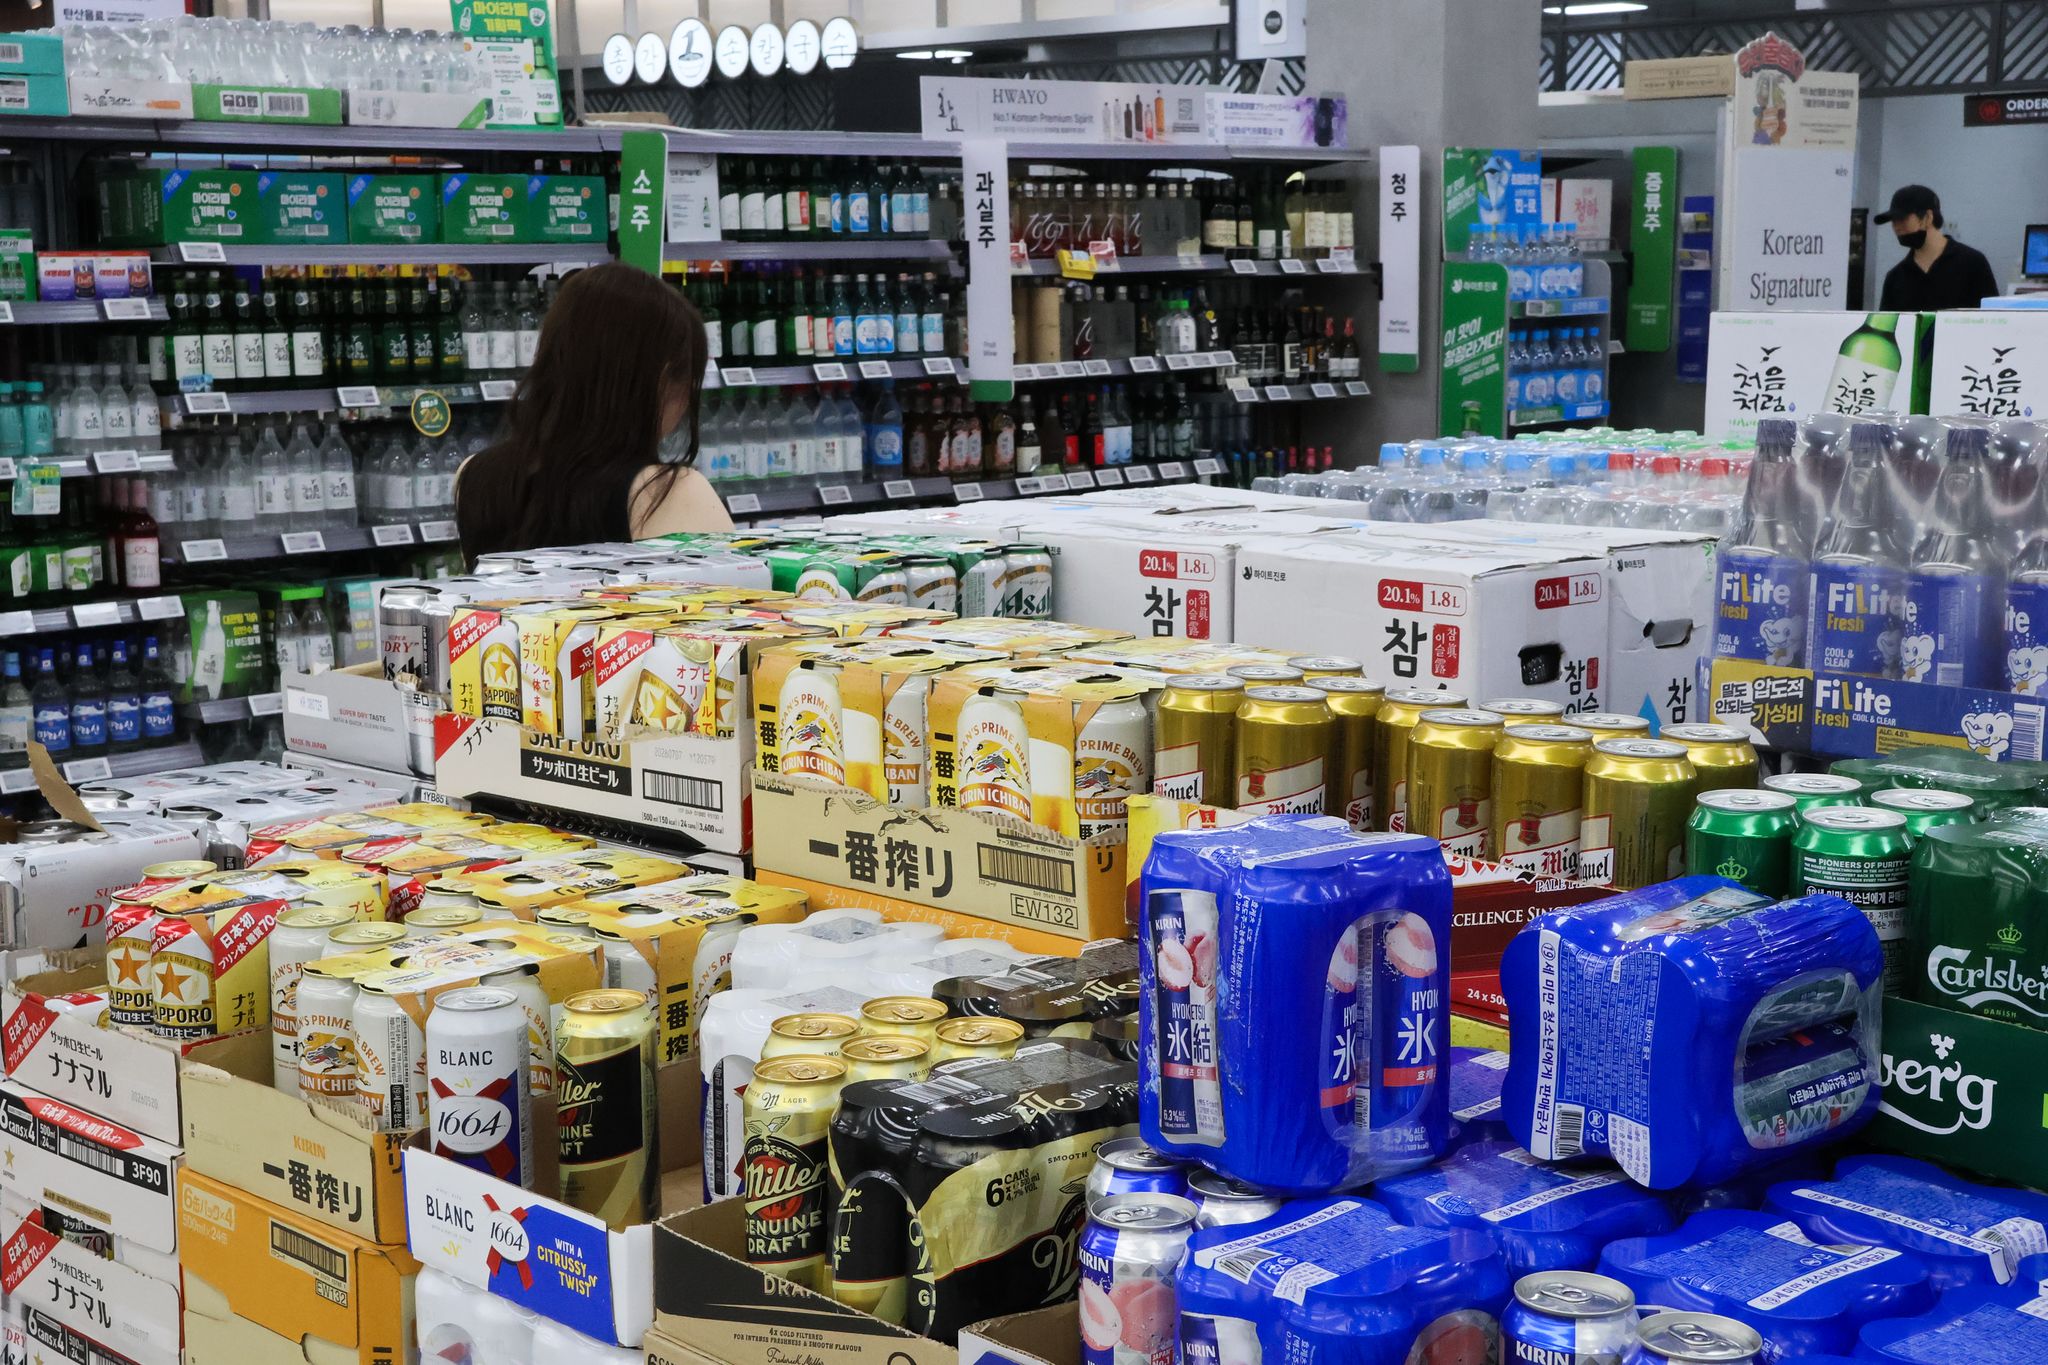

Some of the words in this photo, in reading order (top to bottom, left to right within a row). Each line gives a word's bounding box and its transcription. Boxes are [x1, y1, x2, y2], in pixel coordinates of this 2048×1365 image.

[63, 8, 105, 22] 탄산음료
[993, 89, 1048, 104] HWAYO
[2006, 98, 2048, 111] ORDER
[1011, 112, 1037, 122] Korean
[1039, 113, 1072, 124] Premium
[1074, 113, 1094, 124] Spirit
[630, 168, 653, 232] 소주
[975, 171, 996, 249] 과실주
[1391, 173, 1408, 223] 청주
[1643, 171, 1663, 233] 증류주
[1762, 228, 1824, 256] Korean
[1750, 273, 1832, 305] Signature
[1733, 363, 1787, 392] 처음
[1961, 365, 2022, 396] 처음
[1732, 391, 1787, 413] 처럼
[1960, 394, 2022, 418] 처럼
[1143, 555, 1176, 573] 20.1%
[1253, 569, 1287, 582] 하이트진로
[1382, 584, 1421, 605] 20.1%
[1539, 583, 1569, 602] 20.1%
[1721, 571, 1792, 606] FiLite
[1143, 585, 1182, 638] 참
[1719, 602, 1749, 621] Fresh
[1826, 612, 1866, 633] Fresh
[452, 616, 478, 641] 日本初
[600, 635, 628, 663] 日本初
[1382, 617, 1429, 679] 참
[1824, 647, 1846, 660] COOL
[541, 634, 552, 692] ビールで
[1823, 657, 1851, 669] CLEAR
[531, 632, 543, 723] プリン体まで
[1564, 660, 1587, 696] 참
[1721, 683, 1748, 698] 말도
[1753, 678, 1804, 700] 압도적
[413, 693, 430, 707] 辛口
[483, 688, 520, 707] SAPPORO
[700, 668, 713, 737] ビールで
[801, 692, 830, 712] PRIME
[1665, 677, 1692, 724] 참
[1815, 678, 1892, 715] FiLite
[339, 707, 356, 718] SUPER
[357, 711, 368, 719] DRY
[368, 713, 387, 723] TASTE
[484, 705, 521, 721] サッポロ生ビール
[1714, 699, 1753, 715] 안되는
[1752, 703, 1804, 726] 가성비
[1814, 709, 1850, 729] Fresh
[1852, 713, 1869, 723] COOL
[1876, 716, 1897, 726] CLEAR
[290, 737, 305, 746] MADE
[311, 741, 328, 751] JAPAN
[893, 718, 922, 749] BREW
[981, 721, 1015, 745] PRIME
[1014, 742, 1032, 785] BREW
[1080, 739, 1121, 754] PRIME
[1121, 746, 1145, 777] BREW
[532, 755, 620, 789] サッポロ生ビール
[783, 755, 804, 774] KIRIN
[805, 755, 844, 784] ICHIBAN
[960, 789, 985, 806] KIRIN
[986, 788, 1031, 819] ICHIBAN
[809, 828, 953, 898] 一番搾り
[1818, 857, 1862, 870] PIONEERS
[1863, 861, 1875, 869] OF
[1877, 860, 1904, 870] PURITY
[1014, 896, 1075, 926] EW132
[1844, 891, 1887, 905] 청소년에게
[218, 911, 256, 950] 日本初
[1155, 917, 1183, 931] KIRIN
[1467, 988, 1480, 1001] 24
[1481, 993, 1488, 1002] x
[1542, 986, 1556, 1006] 미만
[311, 1014, 352, 1032] PRIME
[1171, 1002, 1207, 1021] HYOKETSU
[1983, 1008, 2018, 1019] DANISH
[8, 1010, 29, 1044] 日本初
[50, 1029, 104, 1062] サッポロ生ビール
[1166, 1020, 1213, 1065] 氷結
[1540, 1010, 1555, 1080] 청소년에게
[360, 1040, 386, 1076] BREW
[440, 1049, 493, 1067] BLANC
[48, 1051, 113, 1099] ナナマル
[39, 1102, 67, 1122] 日本初
[782, 1097, 808, 1105] LAGER
[1534, 1084, 1552, 1136] 판매금지
[437, 1107, 503, 1137] 1664
[293, 1134, 327, 1161] KIRIN
[1047, 1151, 1089, 1165] SMOOTH
[131, 1160, 162, 1187] 3F90
[745, 1160, 828, 1201] Miller
[1005, 1185, 1013, 1194] x
[1018, 1177, 1031, 1188] 500
[1031, 1174, 1041, 1183] ml
[262, 1158, 363, 1223] 一番搾り
[985, 1177, 1006, 1208] 6
[1004, 1167, 1031, 1184] CANS
[1006, 1189, 1024, 1202] 4.7%
[1024, 1183, 1039, 1194] VOL.
[425, 1194, 475, 1233] BLANC
[744, 1209, 824, 1236] GENUINE
[490, 1221, 525, 1252] 1664
[1846, 1200, 1875, 1215] 미만
[1874, 1210, 1944, 1240] 청소년에게
[1944, 1232, 1999, 1256] 판매금지
[8, 1232, 29, 1265] 日本初
[554, 1237, 575, 1256] WITH
[576, 1245, 583, 1259] A
[747, 1231, 812, 1254] DRAFT
[50, 1256, 104, 1292] サッポロ生ビール
[536, 1244, 588, 1278] CITRUSSY
[1078, 1248, 1110, 1275] KIRIN
[1786, 1282, 1806, 1296] 미만
[1804, 1263, 1852, 1288] 청소년에게
[1851, 1249, 1889, 1267] 판매금지
[316, 1281, 347, 1305] EW132
[558, 1270, 591, 1298] TWIST
[47, 1277, 112, 1329] ナナマル
[28, 1307, 38, 1337] 6
[779, 1330, 796, 1339] COLD
[797, 1331, 824, 1341] FILTERED
[733, 1333, 745, 1341] FOR
[744, 1334, 770, 1343] INTENSE
[770, 1336, 803, 1347] FRESHNESS
[808, 1341, 834, 1351] SMOOTH
[834, 1343, 863, 1353] FLAVOUR
[1152, 1350, 1171, 1361] JAPAN
[1185, 1342, 1216, 1358] KIRIN
[1515, 1340, 1570, 1365] KIRIN
[647, 1352, 658, 1365] 6
